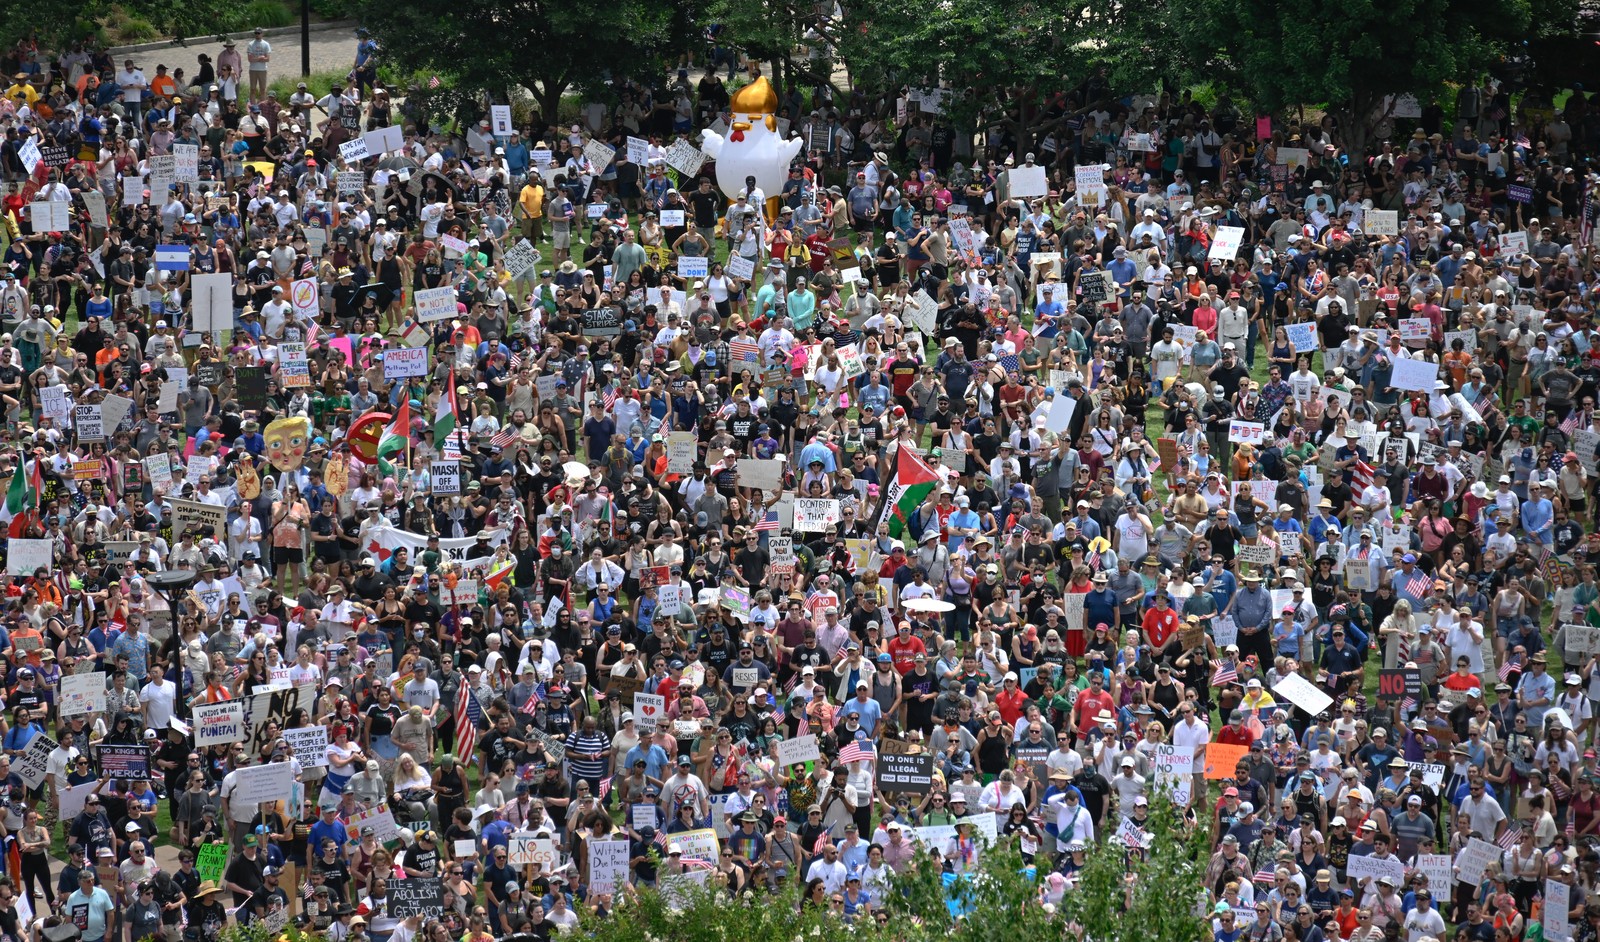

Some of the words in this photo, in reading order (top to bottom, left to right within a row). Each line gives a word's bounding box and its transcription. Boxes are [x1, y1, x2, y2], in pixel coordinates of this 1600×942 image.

[417, 288, 452, 300] HEALTHCARE
[430, 298, 445, 308] NOT
[420, 307, 455, 317] WEALTHCARE
[587, 320, 617, 328] STRIPES
[386, 350, 423, 361] AMERICA
[41, 389, 62, 398] ABOLISH
[45, 397, 61, 412] ICE
[77, 406, 92, 415] STOP
[1231, 426, 1262, 438] FDT
[74, 462, 100, 470] JUSTICE
[433, 466, 458, 476] MASK
[1262, 482, 1275, 491] HAS
[735, 673, 757, 682] RESIST
[1380, 675, 1404, 695] NO
[268, 688, 299, 717] NO
[636, 696, 655, 704] WHERE
[199, 709, 219, 718] UNIDOS
[200, 725, 236, 738] PUÑETA!
[780, 740, 801, 749] DOWN
[1159, 746, 1174, 755] NO
[1159, 755, 1190, 765] THRONES
[21, 765, 36, 778] TOO
[888, 765, 919, 773] ILLEGAL
[1157, 764, 1172, 773] NO
[102, 770, 147, 778] AMERICA
[670, 833, 713, 843] DEPORTATION
[202, 845, 222, 854] REJECT
[593, 844, 627, 856] Without
[199, 855, 225, 865] TYRANNY
[416, 851, 435, 861] PUNCH
[510, 852, 551, 862] KINGS
[419, 860, 435, 868] YOUR
[593, 858, 608, 868] Due
[610, 857, 628, 866] Process
[1423, 857, 1445, 866] HATE
[389, 879, 406, 889] ICE
[1549, 882, 1564, 894] THE
[393, 889, 438, 900] ABOLISH
[394, 906, 443, 918] GESTAPO!
[1550, 920, 1560, 930] IS
[1545, 928, 1566, 941] MELTING
